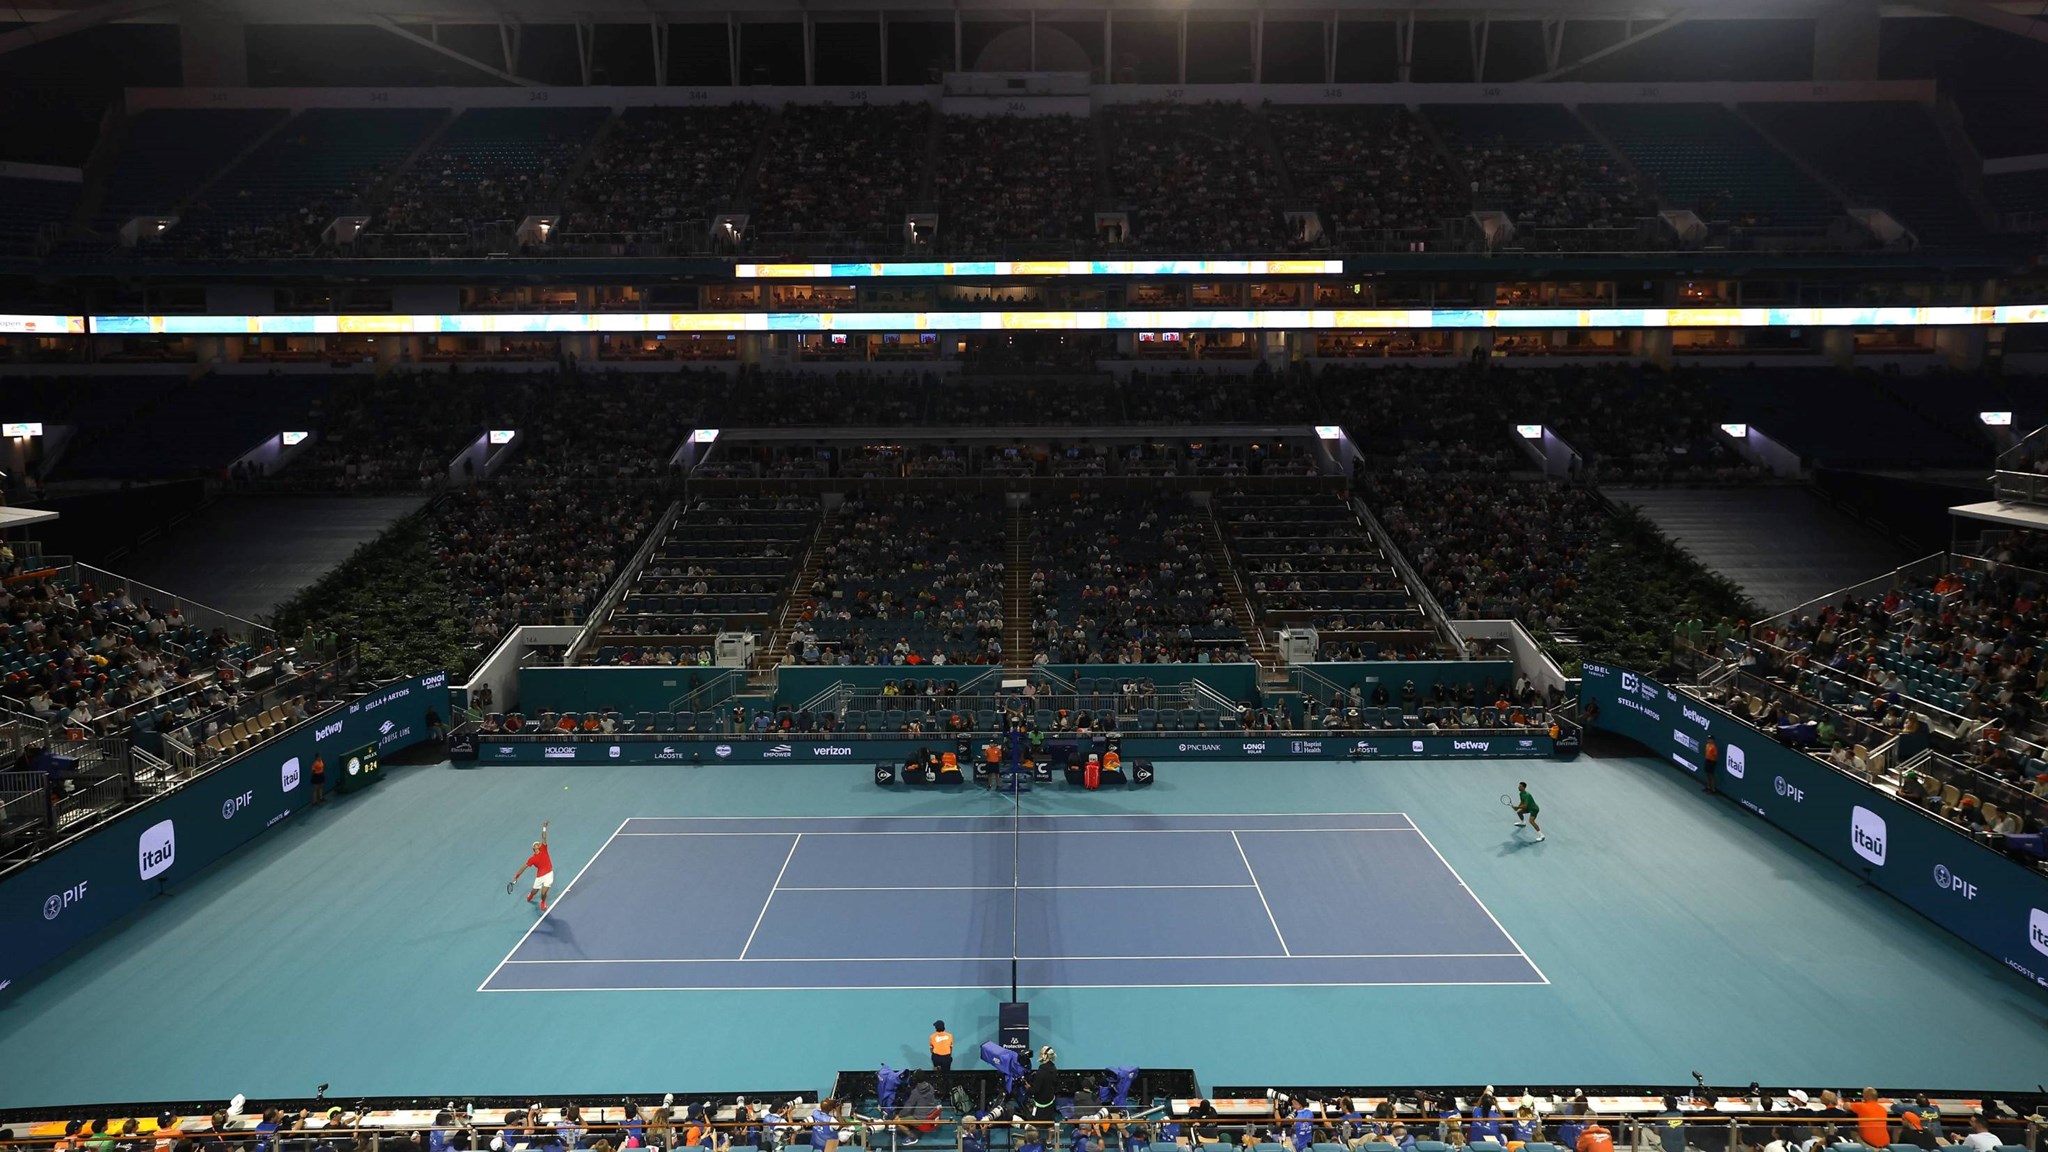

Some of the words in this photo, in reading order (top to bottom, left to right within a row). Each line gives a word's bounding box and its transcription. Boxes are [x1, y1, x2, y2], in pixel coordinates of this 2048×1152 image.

[688, 90, 708, 100] 344
[849, 90, 868, 100] 345
[1007, 102, 1026, 112] 346
[1583, 663, 1610, 674] DOBEL
[364, 698, 383, 712] STELLA
[388, 688, 410, 702] ARTOIS
[1618, 697, 1640, 710] STELLA
[1683, 704, 1710, 730] betway
[315, 720, 343, 742] betway
[814, 746, 851, 756] verizon
[1454, 740, 1490, 751] betway
[1728, 755, 1743, 773] itaú
[283, 770, 298, 787] itaú
[236, 790, 253, 811] PIF
[1787, 784, 1804, 803] PIF
[1854, 825, 1882, 857] itaú
[142, 840, 172, 871] itaú
[63, 880, 88, 908] PIF
[1952, 875, 1978, 900] PIF
[2032, 924, 2048, 948] ita
[2004, 957, 2035, 979] LACOSTE
